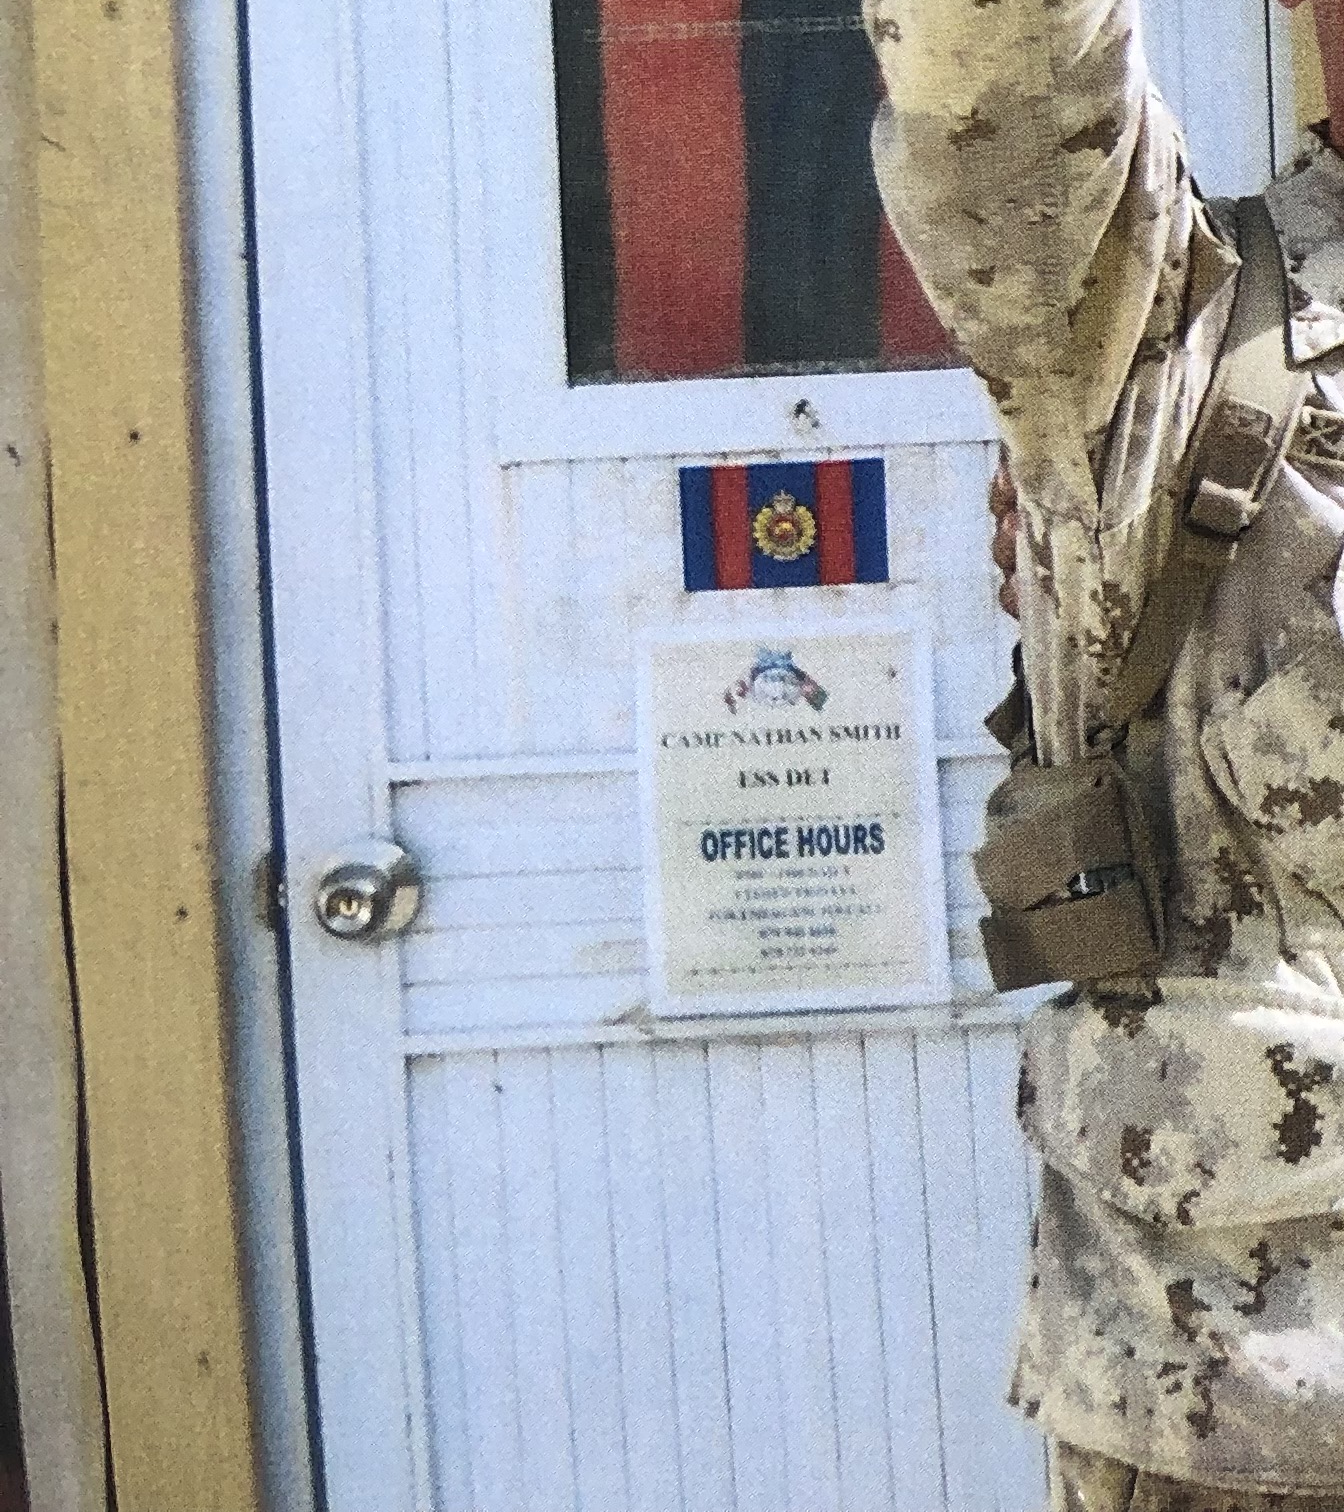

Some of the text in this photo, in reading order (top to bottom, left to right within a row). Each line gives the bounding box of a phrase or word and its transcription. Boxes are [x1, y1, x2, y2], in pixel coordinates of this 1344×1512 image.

[661, 723, 900, 749] CAMP NATHAN SMITH
[700, 821, 887, 863] OFFICE HOURS
